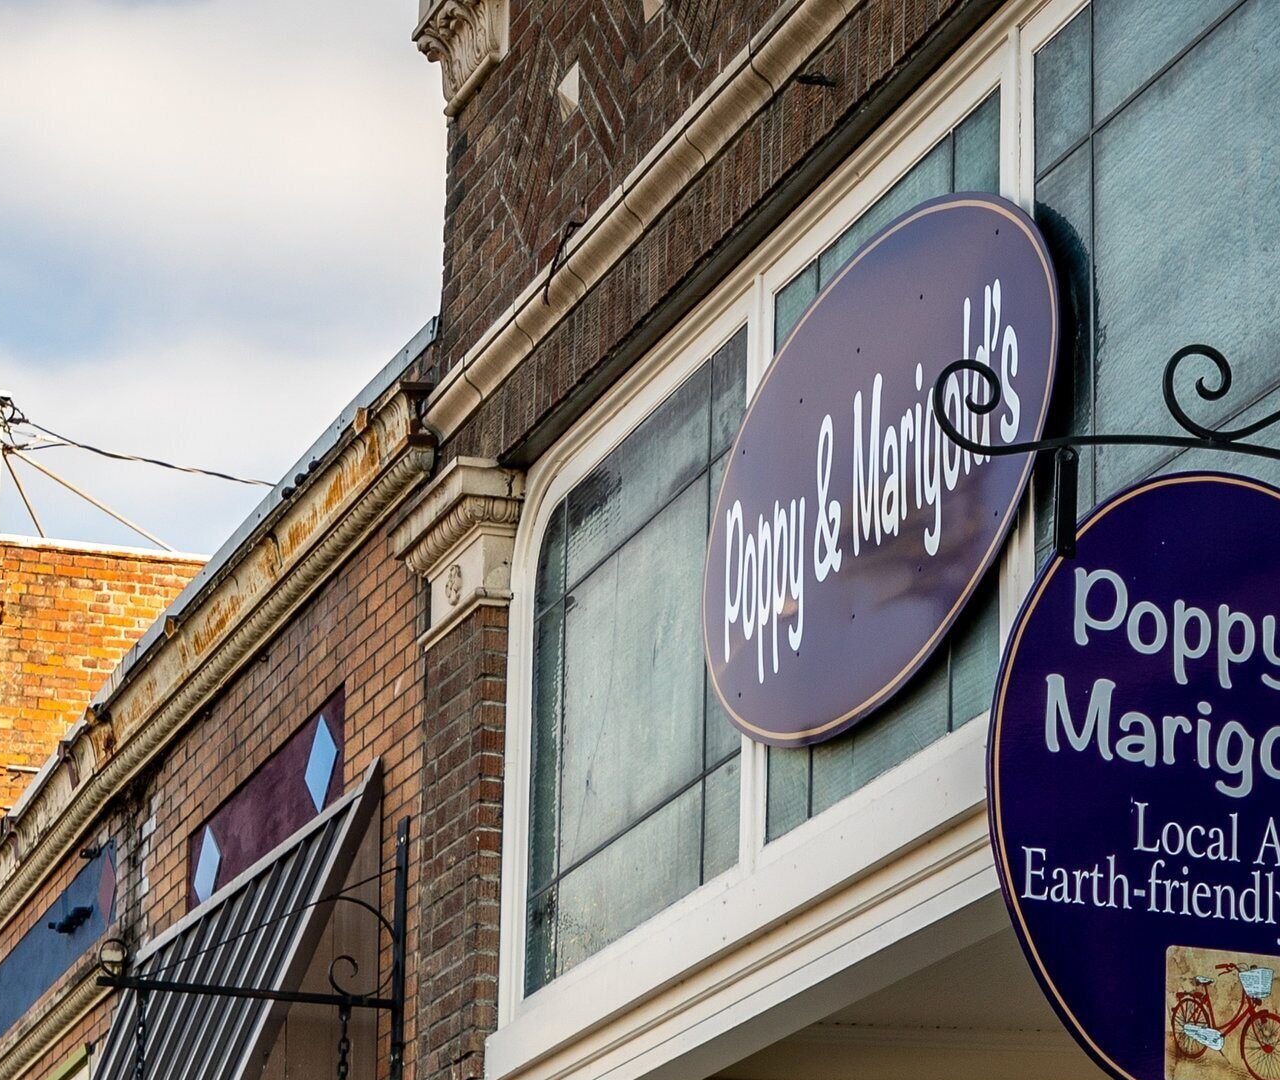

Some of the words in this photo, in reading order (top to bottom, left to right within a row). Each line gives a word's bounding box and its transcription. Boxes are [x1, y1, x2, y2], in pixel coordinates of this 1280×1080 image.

[724, 497, 806, 684] Poppy
[814, 414, 842, 583] &
[852, 278, 1021, 556] Marigold's
[1133, 801, 1240, 863] Local
